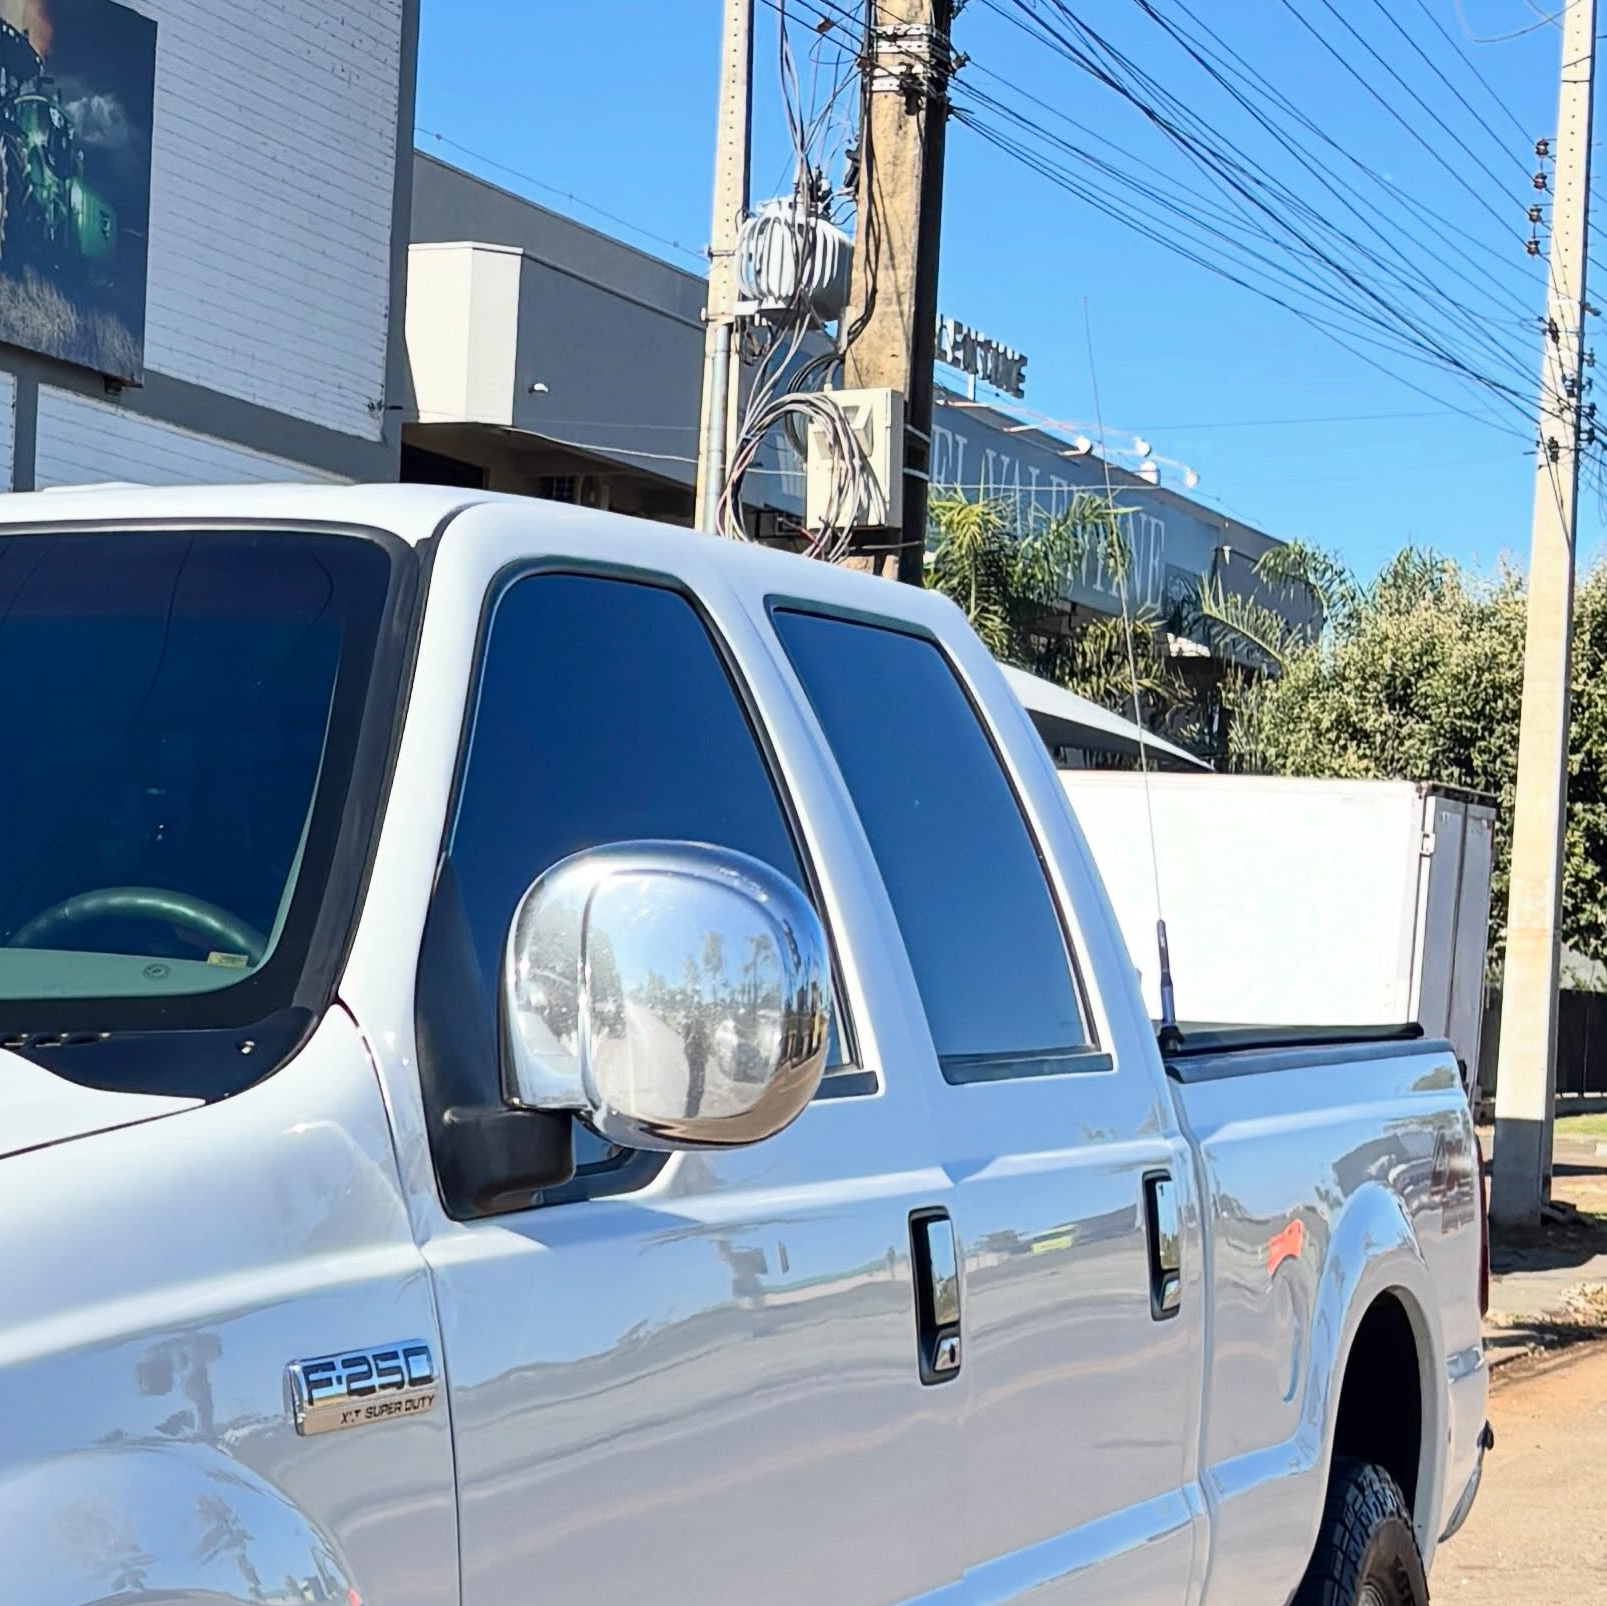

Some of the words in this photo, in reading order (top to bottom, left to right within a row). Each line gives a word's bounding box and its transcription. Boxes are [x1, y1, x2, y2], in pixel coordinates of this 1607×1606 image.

[301, 1345, 435, 1407] F-250
[365, 1400, 403, 1419] SUPER
[405, 1394, 435, 1412] DUTY
